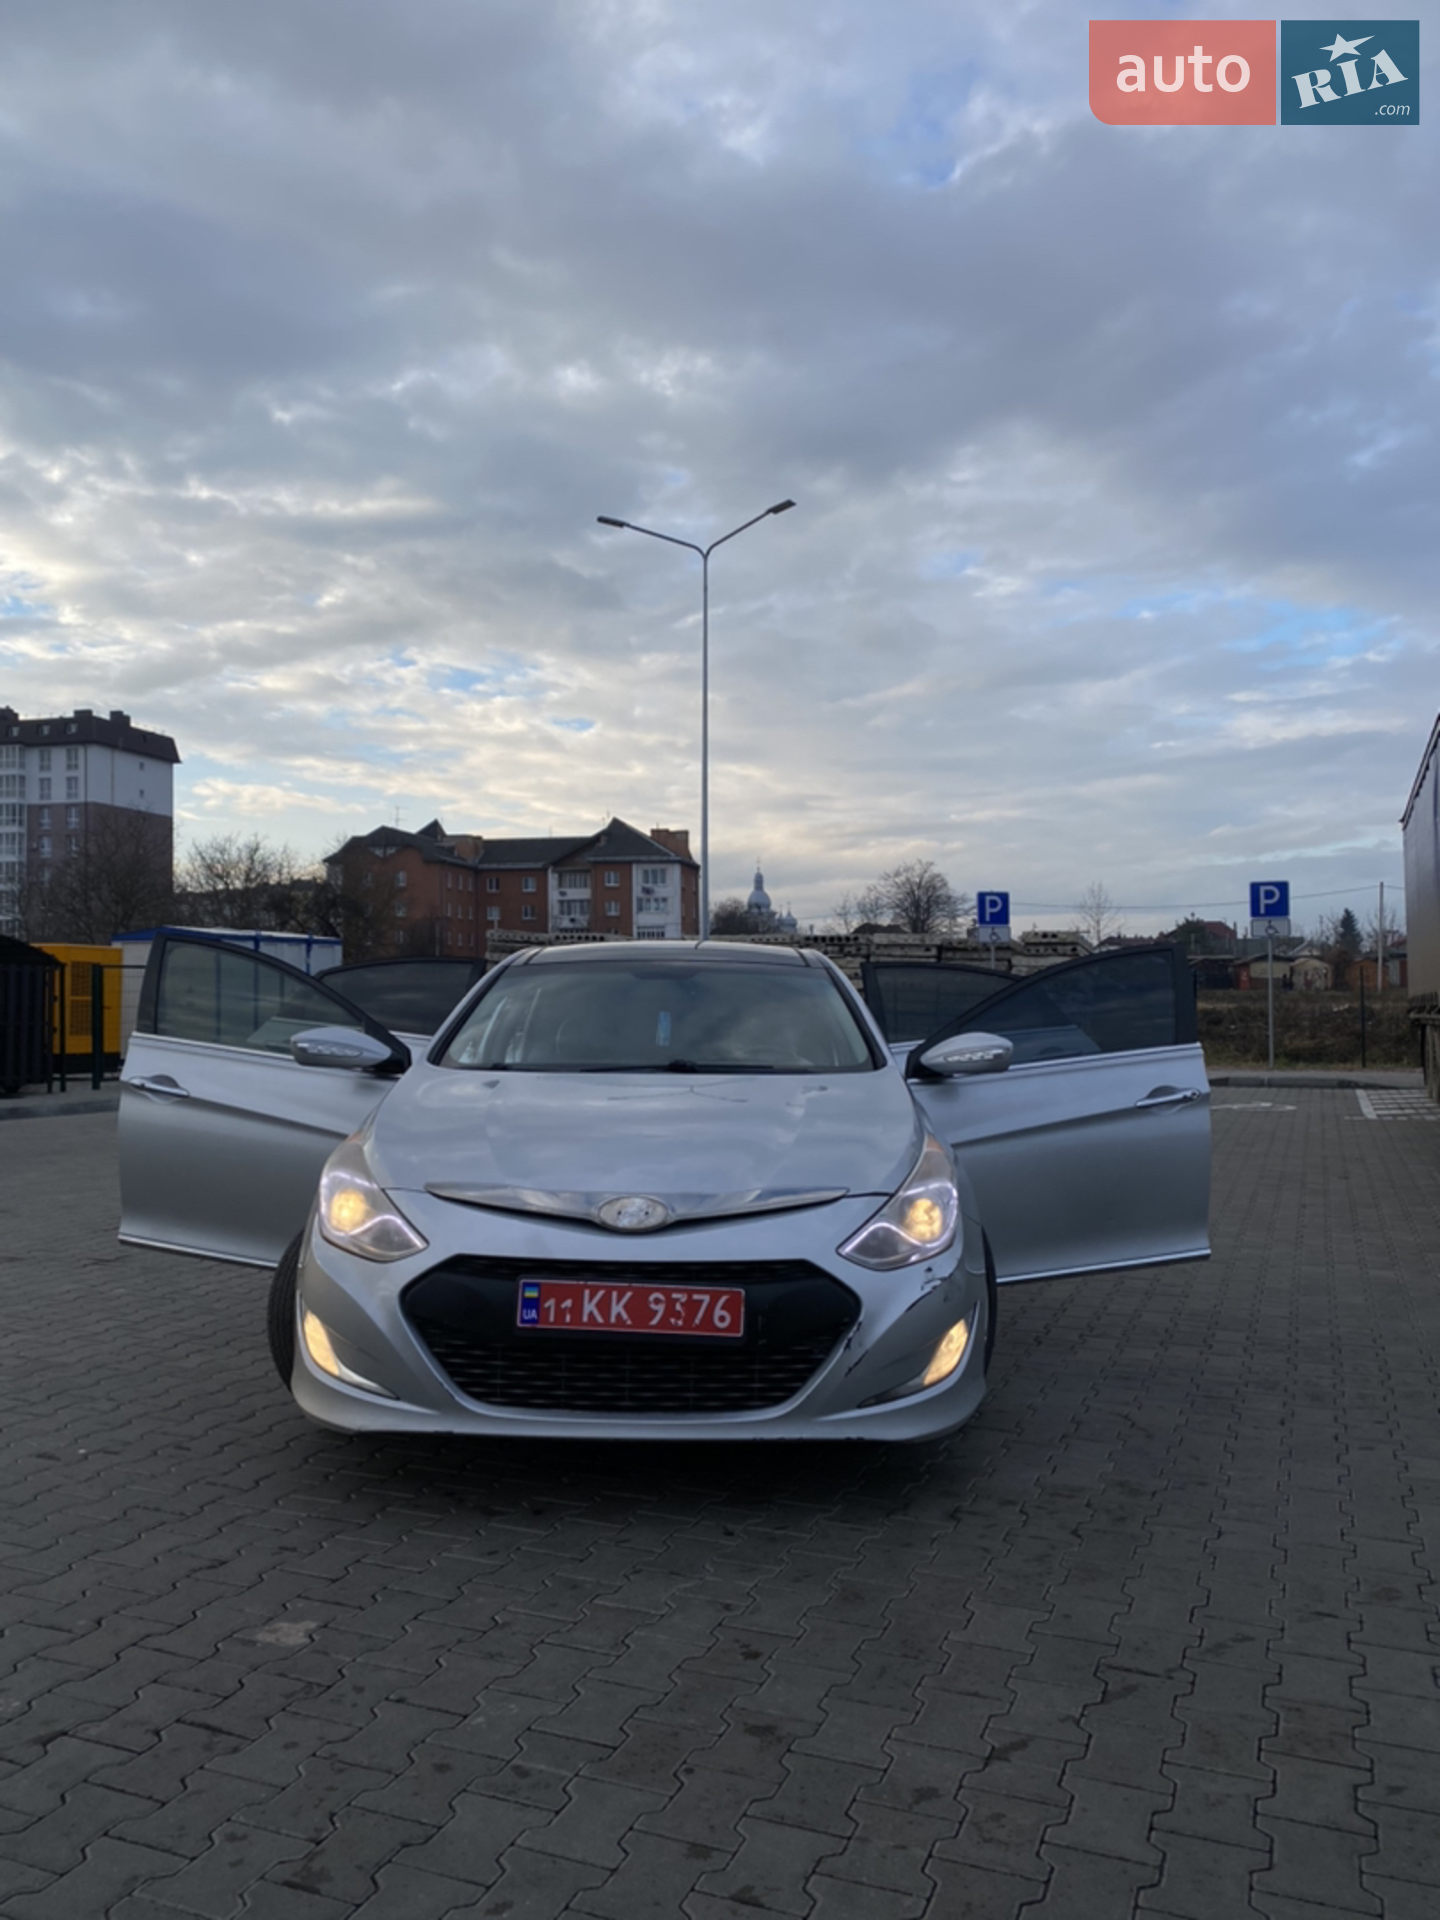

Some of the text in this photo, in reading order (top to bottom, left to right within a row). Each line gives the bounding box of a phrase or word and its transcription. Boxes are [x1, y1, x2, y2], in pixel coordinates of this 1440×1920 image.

[984, 895, 1003, 922] P
[1259, 884, 1281, 914] P
[522, 1309, 538, 1320] UA
[582, 1289, 633, 1325] KK
